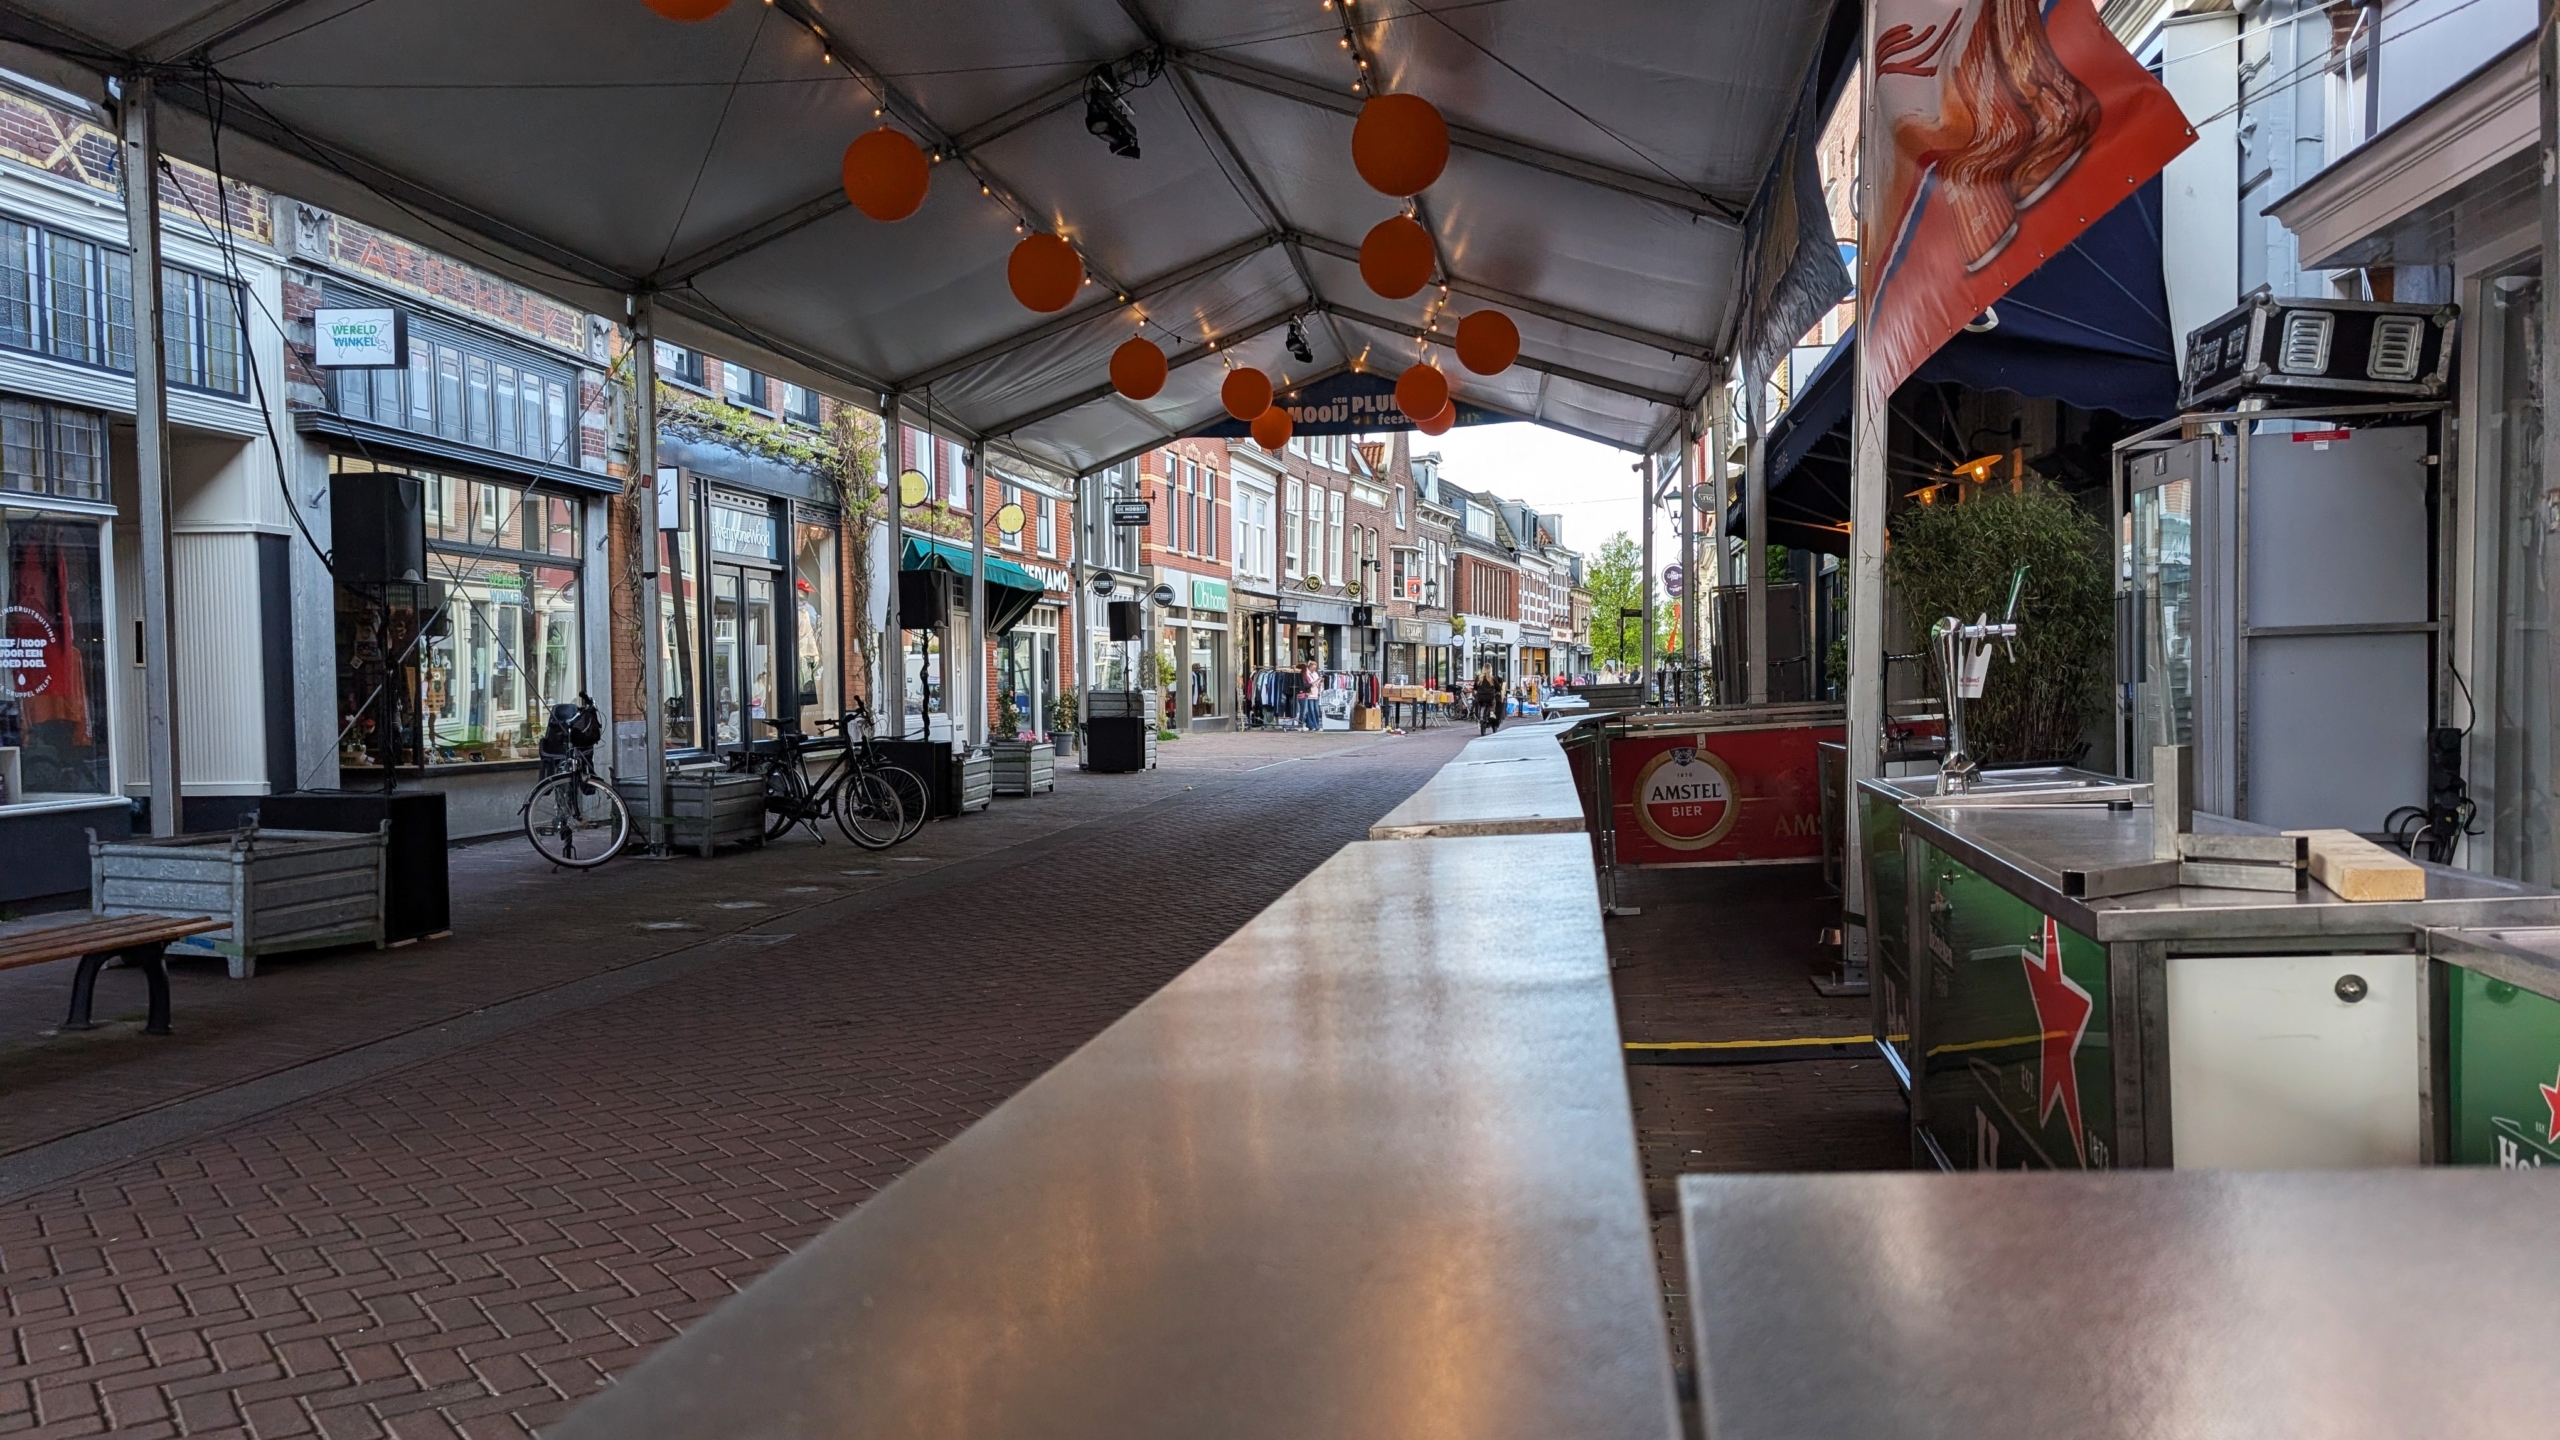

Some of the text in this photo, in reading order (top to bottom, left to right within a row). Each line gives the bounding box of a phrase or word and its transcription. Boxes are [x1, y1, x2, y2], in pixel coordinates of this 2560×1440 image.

[332, 325, 377, 335] WERELD
[333, 336, 377, 347] WINKEL
[1287, 405, 1348, 423] MOOIJ
[711, 521, 771, 547] TwentyoneWood
[488, 572, 524, 589] WERELD
[0, 606, 56, 643] INDERUITBUITING
[21, 639, 47, 648] KOOP
[25, 649, 43, 658] EEN
[22, 660, 47, 668] DOEL
[6, 689, 36, 698] DRUPPEL
[35, 674, 53, 694] HELPT
[1651, 783, 1722, 801] AMSTEL
[1672, 805, 1703, 817] BIER
